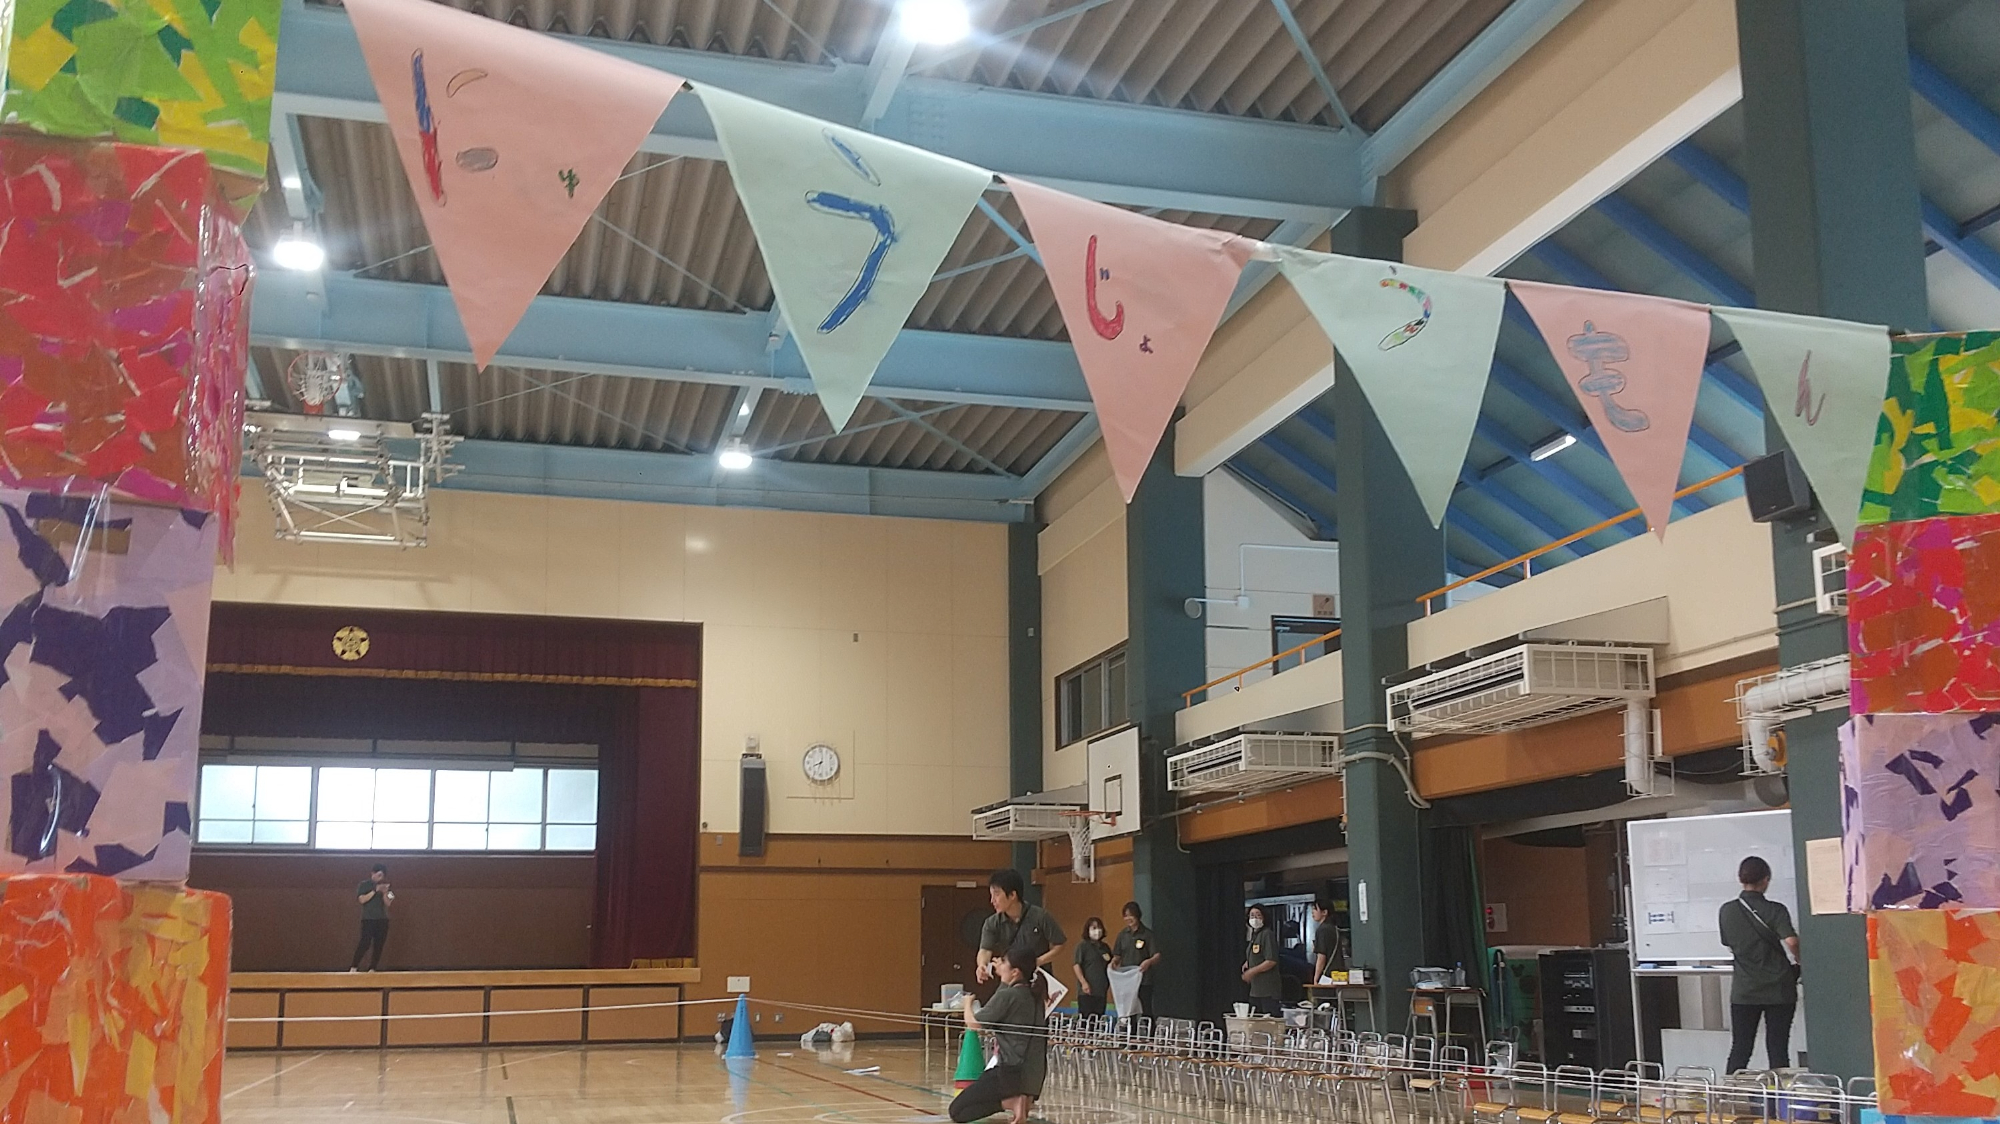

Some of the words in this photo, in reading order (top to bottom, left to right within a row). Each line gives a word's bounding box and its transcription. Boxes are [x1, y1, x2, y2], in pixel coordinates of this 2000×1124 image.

[804, 127, 897, 335] う
[1085, 234, 1154, 354] じょ
[1378, 265, 1432, 351] う
[1566, 320, 1650, 432] も
[1795, 349, 1826, 426] ん
